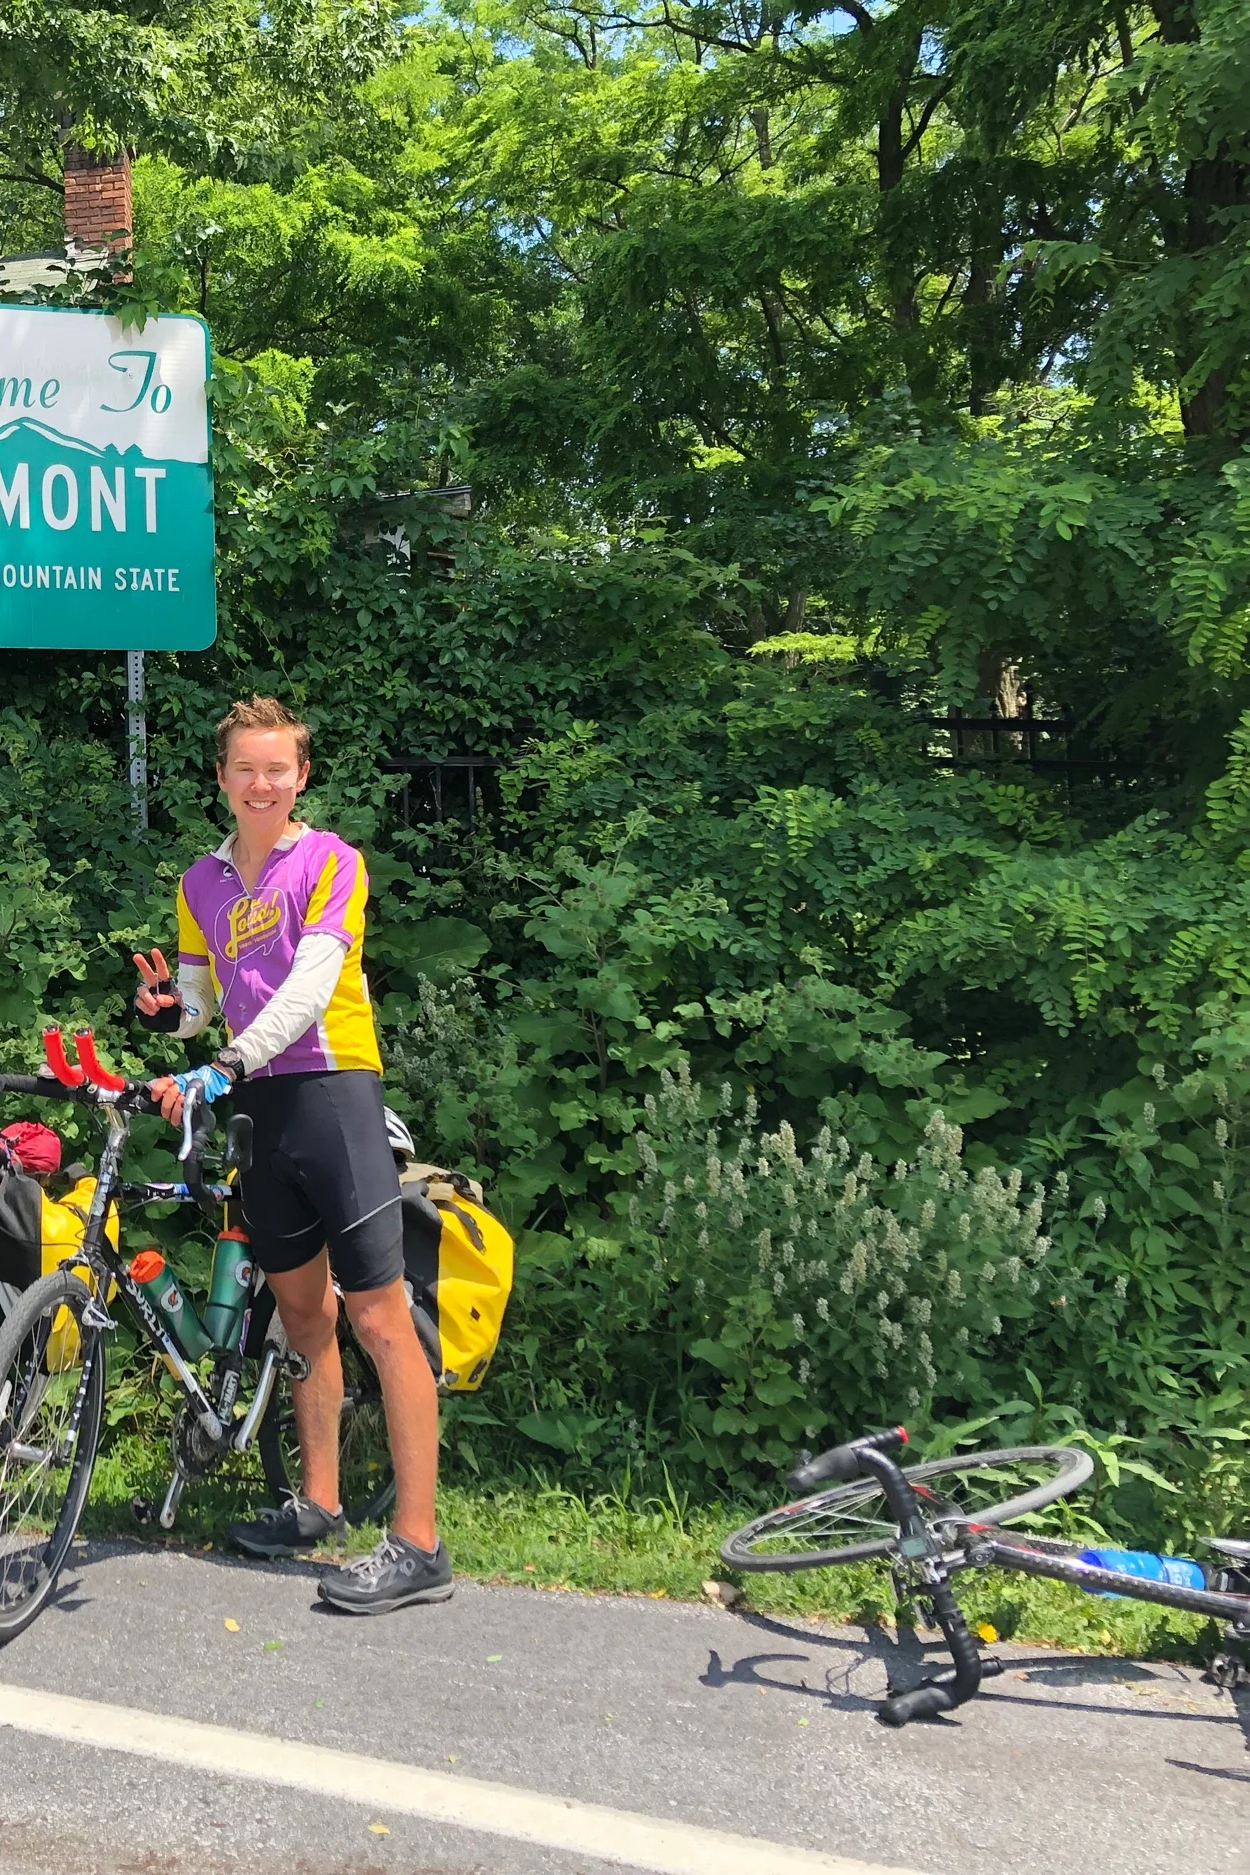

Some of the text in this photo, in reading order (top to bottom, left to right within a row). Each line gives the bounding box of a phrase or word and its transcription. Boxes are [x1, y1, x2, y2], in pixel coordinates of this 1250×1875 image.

[99, 350, 172, 414] To
[114, 567, 180, 592] STATE
[125, 1278, 165, 1337] SURLY
